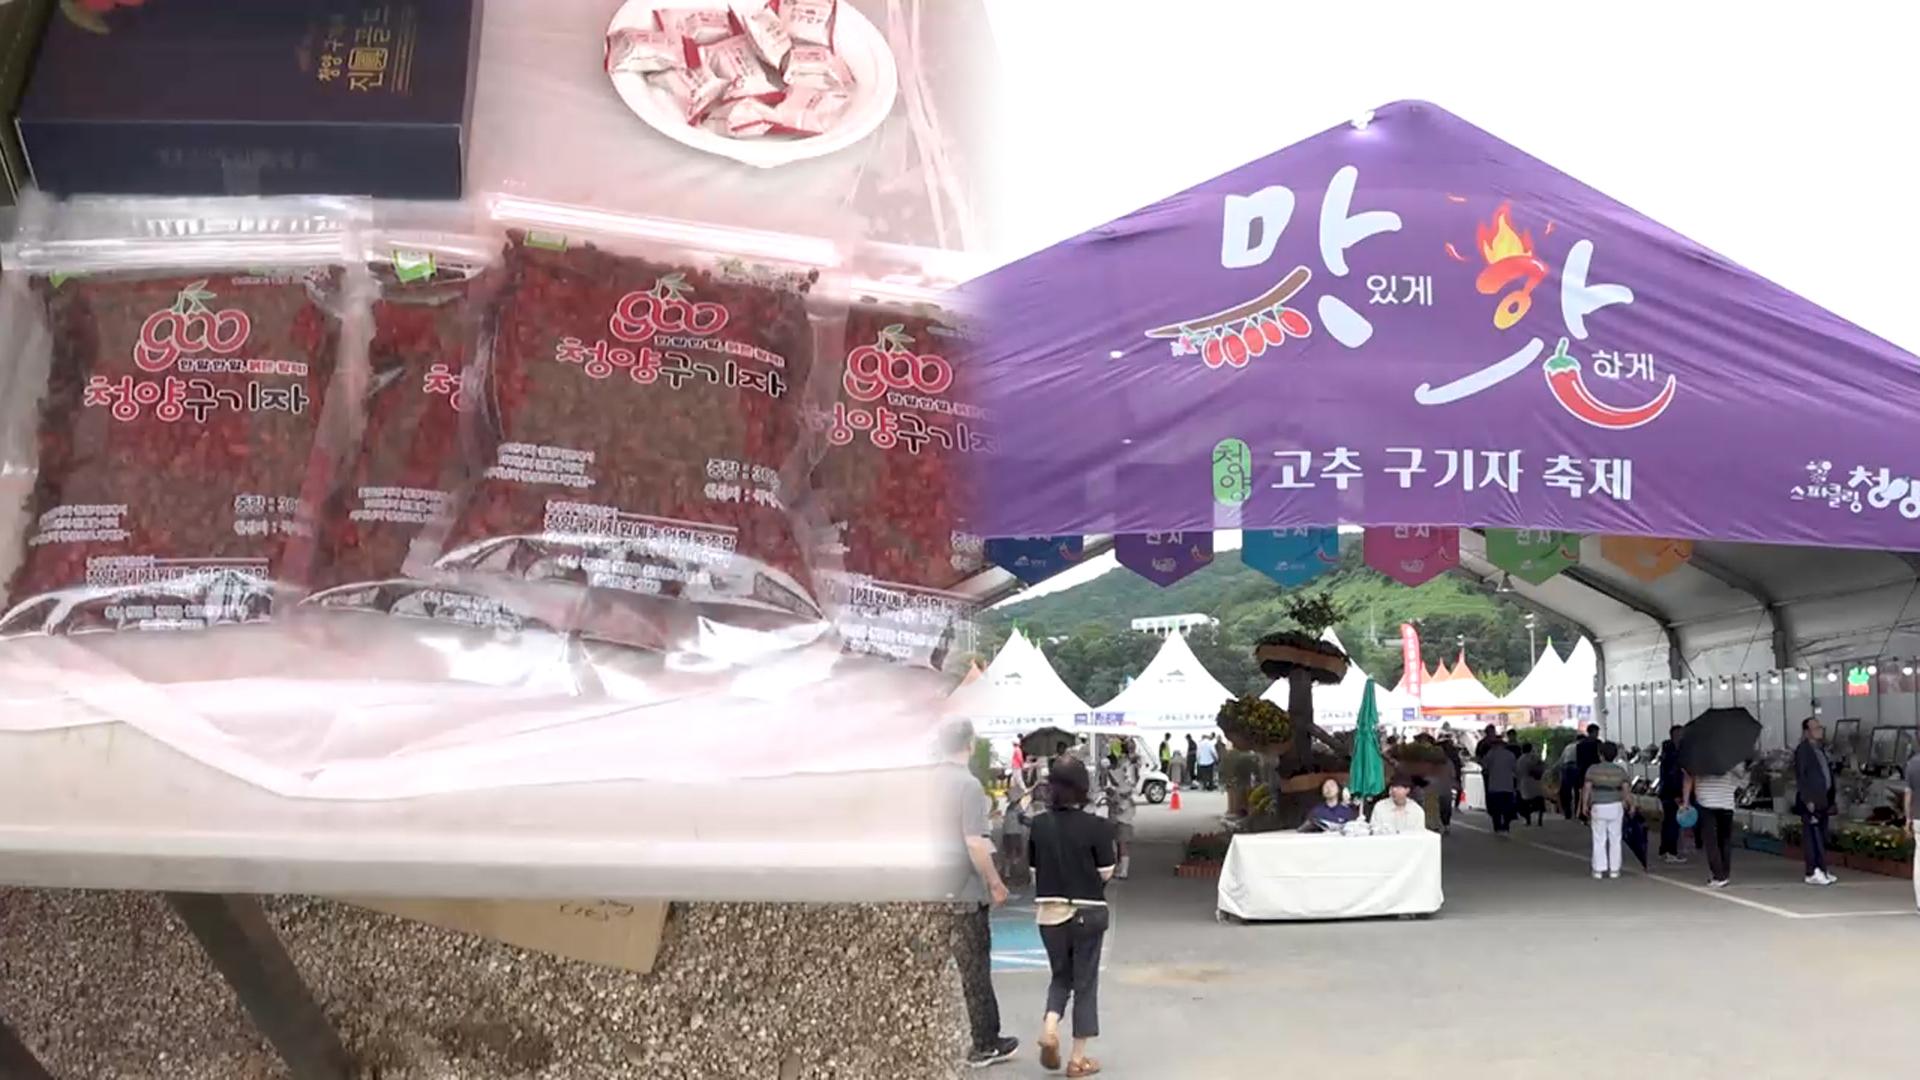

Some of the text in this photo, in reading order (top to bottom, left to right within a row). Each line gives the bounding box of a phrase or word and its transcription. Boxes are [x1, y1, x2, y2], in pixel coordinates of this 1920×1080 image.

[556, 337, 787, 398] 청양구기자
[84, 376, 310, 422] 청양구기자
[1212, 444, 1252, 503] 청양
[1271, 447, 1632, 500] 고추 구기자 축제
[1790, 484, 1862, 513] 스파클링
